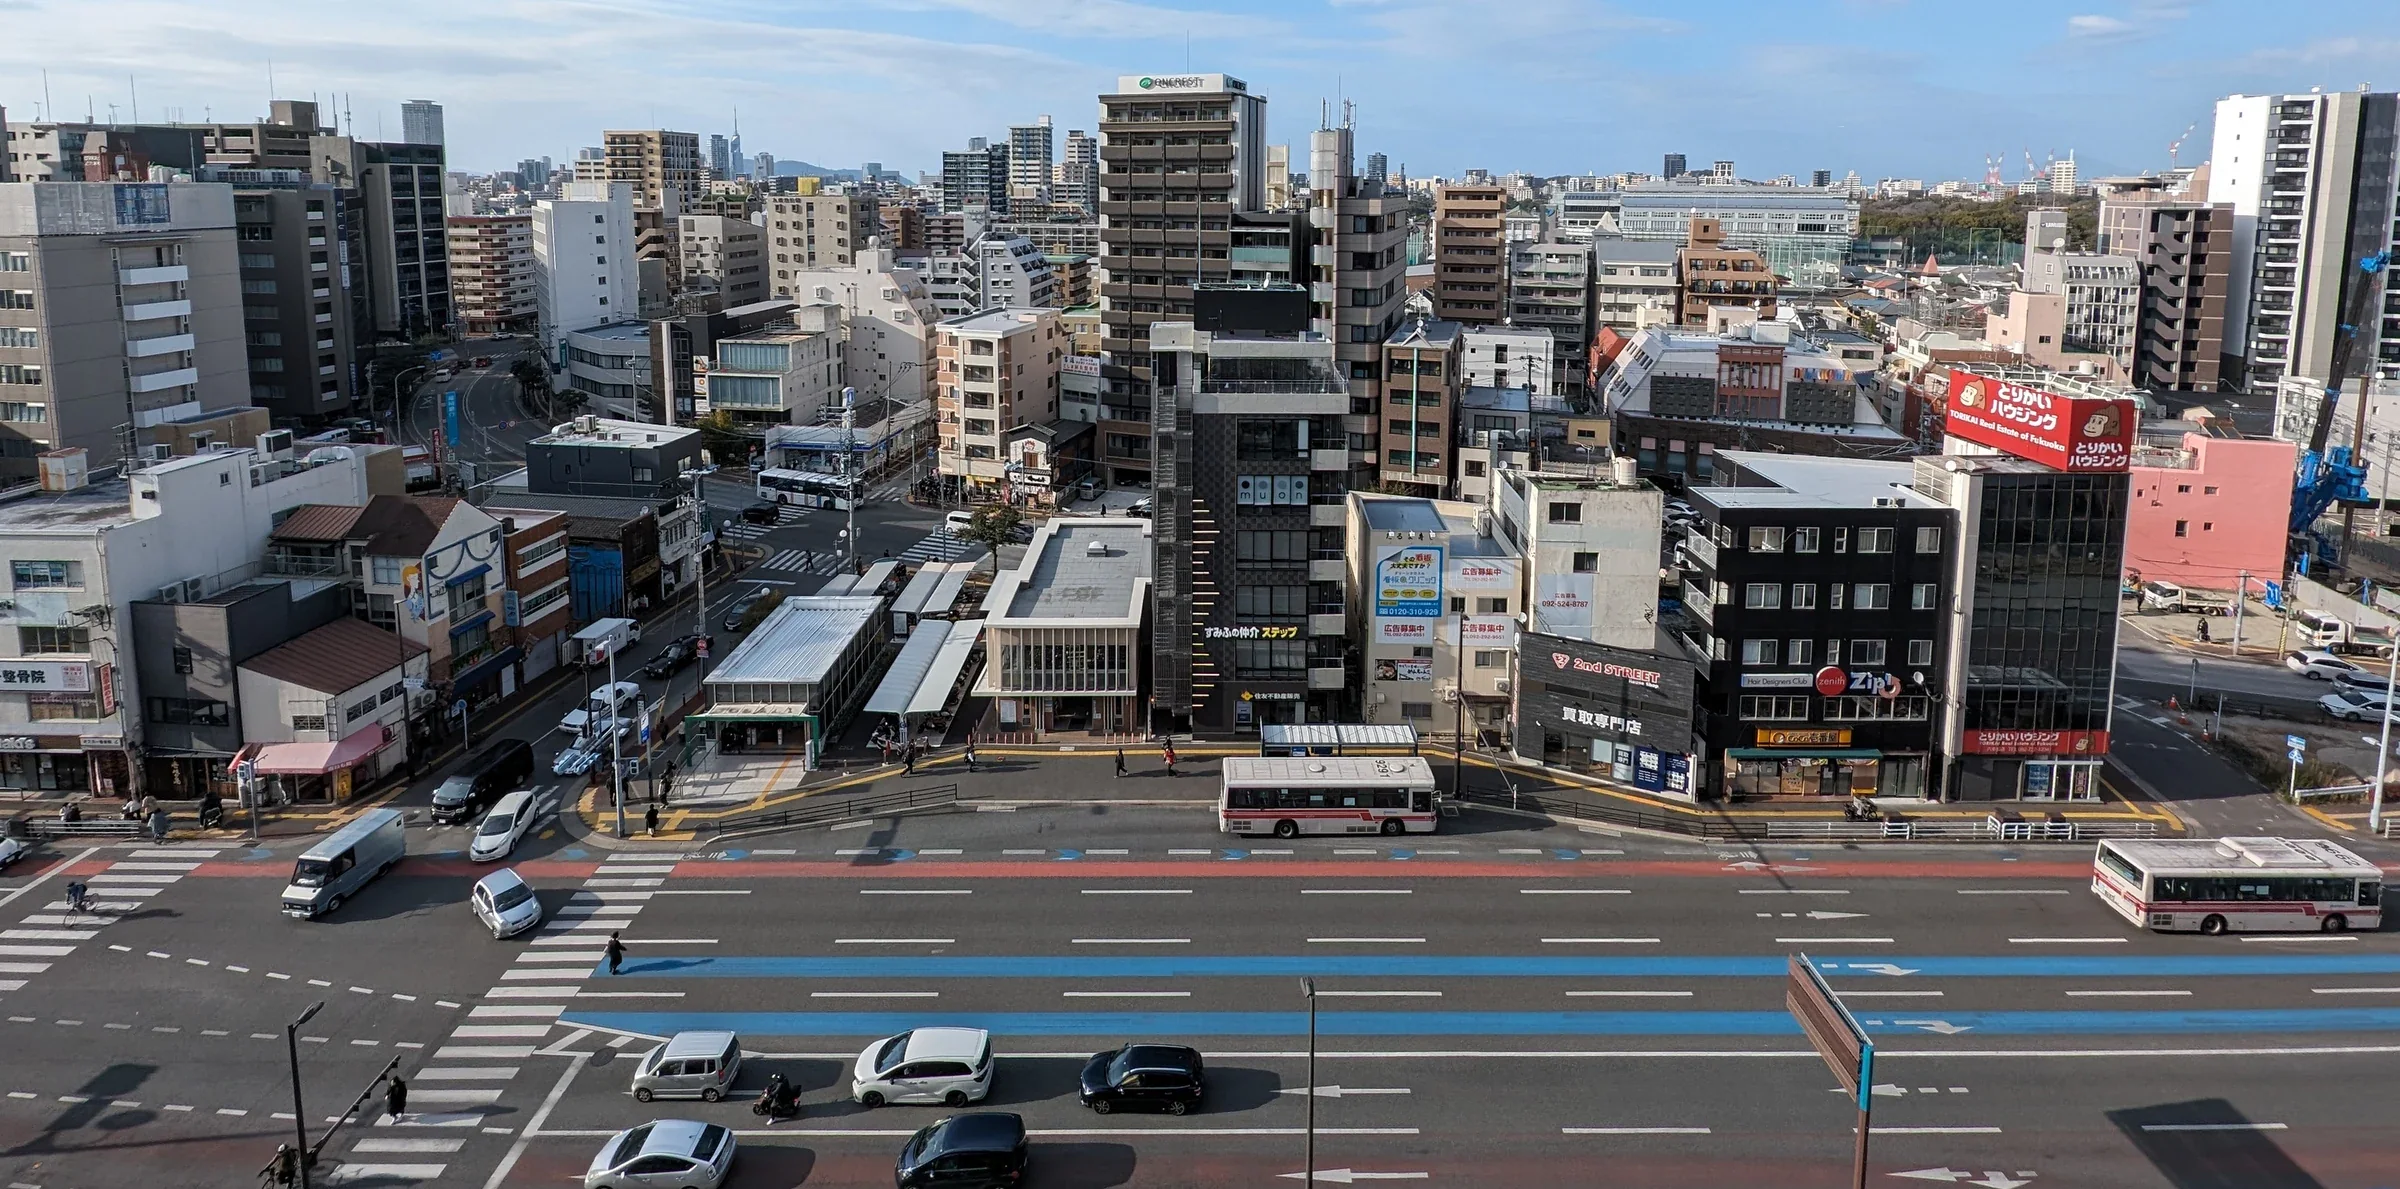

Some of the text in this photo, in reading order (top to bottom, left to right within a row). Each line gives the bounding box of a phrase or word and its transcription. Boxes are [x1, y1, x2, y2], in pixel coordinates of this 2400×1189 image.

[1998, 383, 2052, 409] とりかい
[1990, 401, 2058, 431] ハウジング
[1950, 409, 2066, 453] TORIKAI Real Estate of Fukuoka
[2075, 442, 2123, 454] とりかい
[2068, 454, 2128, 467] ハウジング
[1240, 491, 1303, 500] muon
[1461, 567, 1502, 576] 広告募集中
[1542, 600, 1589, 608] 092-524-8787
[1389, 608, 1439, 616] 0120-310-929
[1204, 626, 1298, 639] すみふの仲介 ステップ
[1384, 624, 1425, 633] 広告募集中
[0, 669, 46, 684] 整骨院
[1573, 657, 1661, 684] 2nd STREET
[1747, 677, 1808, 687] Hair Designers Club
[1818, 675, 1846, 686] zenith
[1561, 705, 1643, 737] 買取専門店
[1978, 731, 2060, 742] とりかいハウジング
[0, 737, 36, 749] ald's
[1375, 759, 1391, 778] 9291
